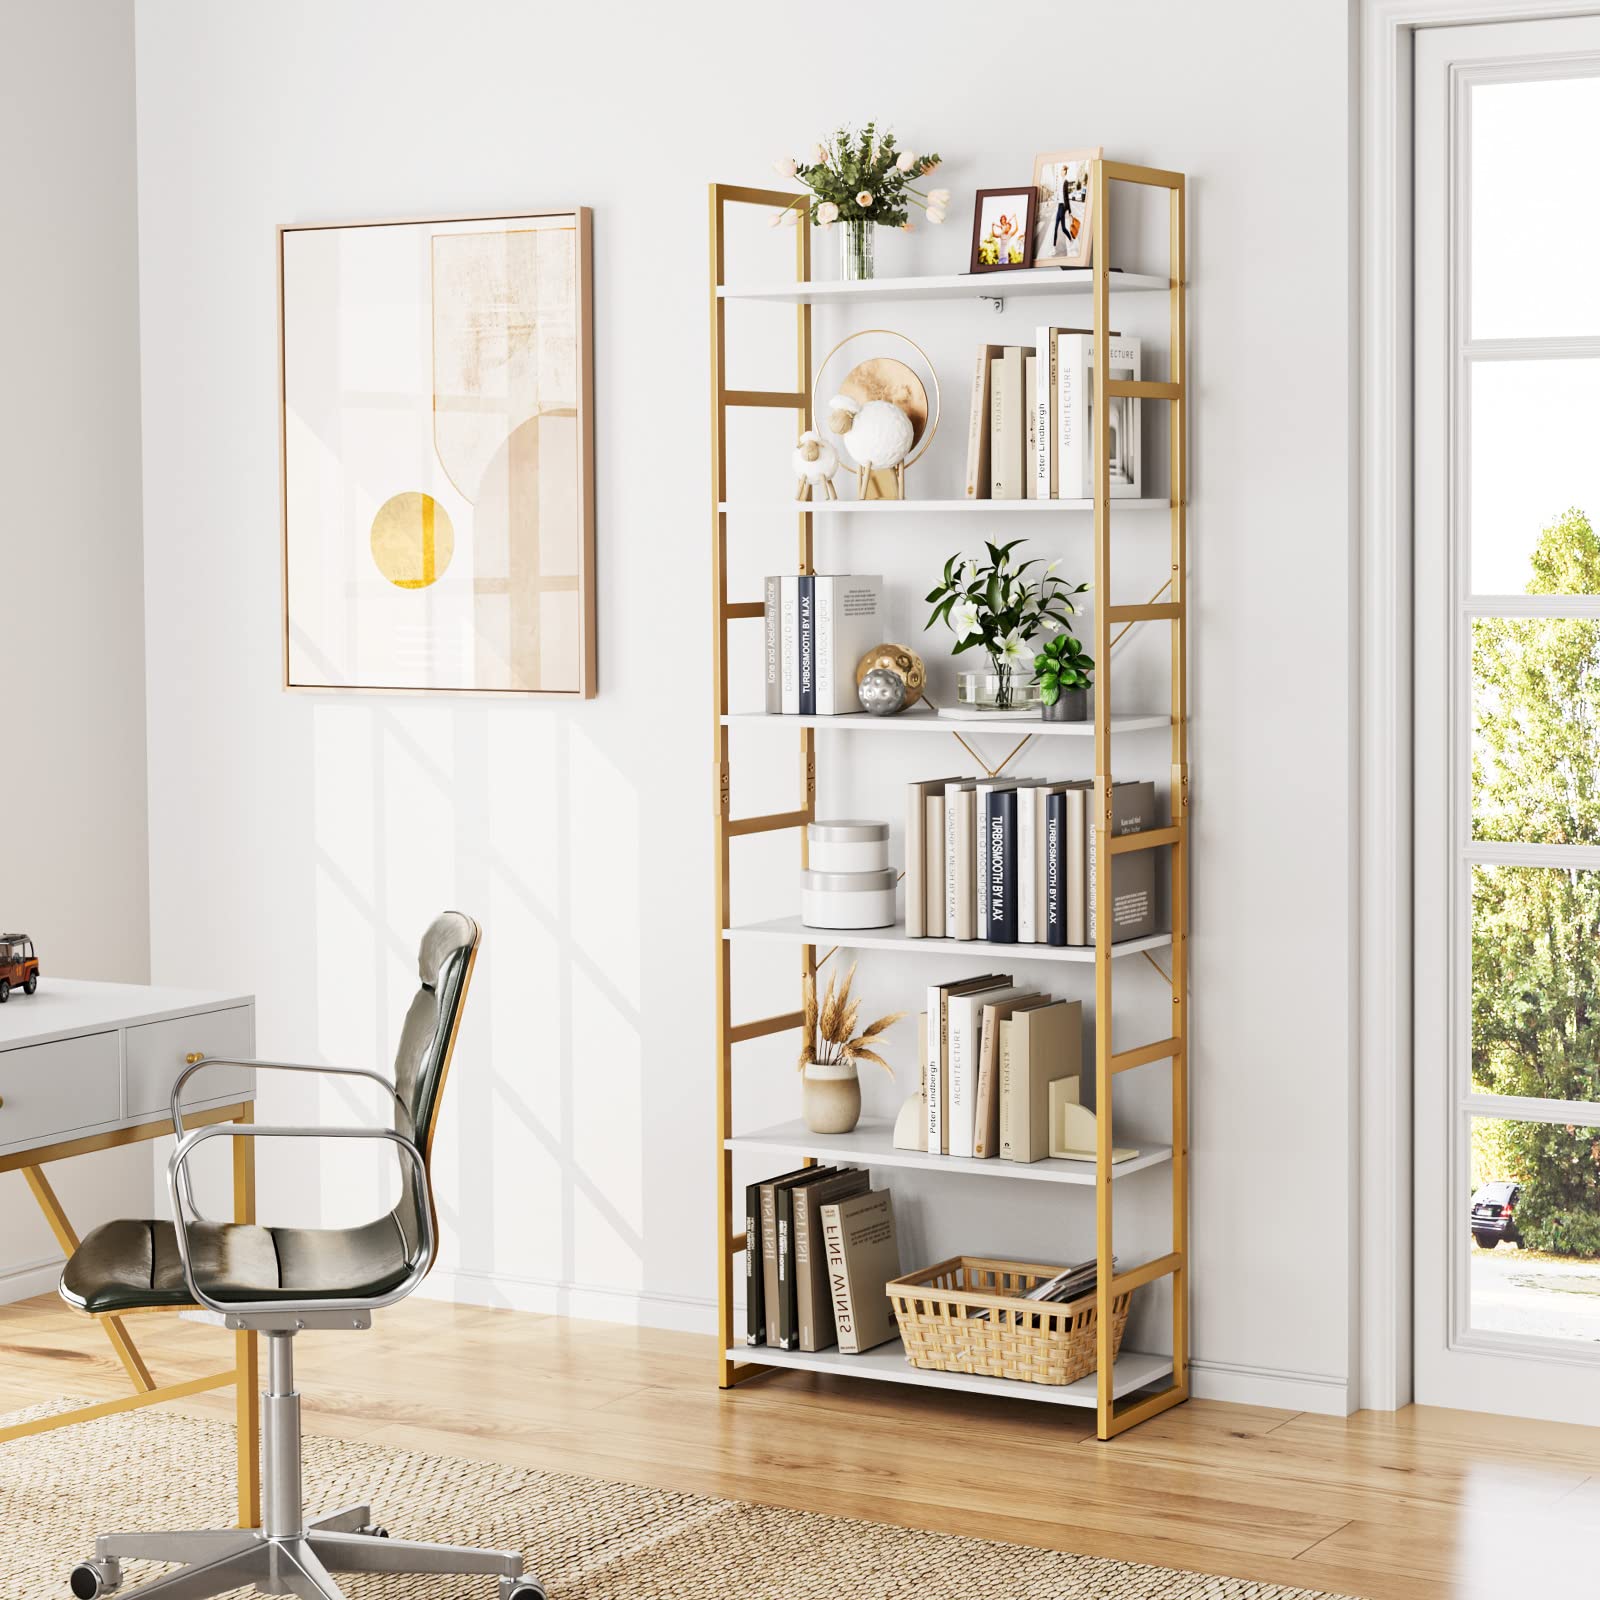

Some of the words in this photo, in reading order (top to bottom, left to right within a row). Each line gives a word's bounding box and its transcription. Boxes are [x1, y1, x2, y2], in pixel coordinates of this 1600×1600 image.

[1088, 349, 1134, 360] AECTURE
[1038, 403, 1047, 452] Lindbergh
[767, 582, 776, 607] Archer
[802, 618, 810, 629] BY
[768, 649, 776, 664] and
[802, 630, 811, 694] TURBOSMOOTH
[768, 665, 776, 683] Kane
[992, 816, 1003, 884] TURBOSMOOTH
[949, 883, 956, 894] BY
[992, 886, 1003, 898] BY
[1050, 888, 1056, 900] BY
[930, 1061, 938, 1108] Lindbergh
